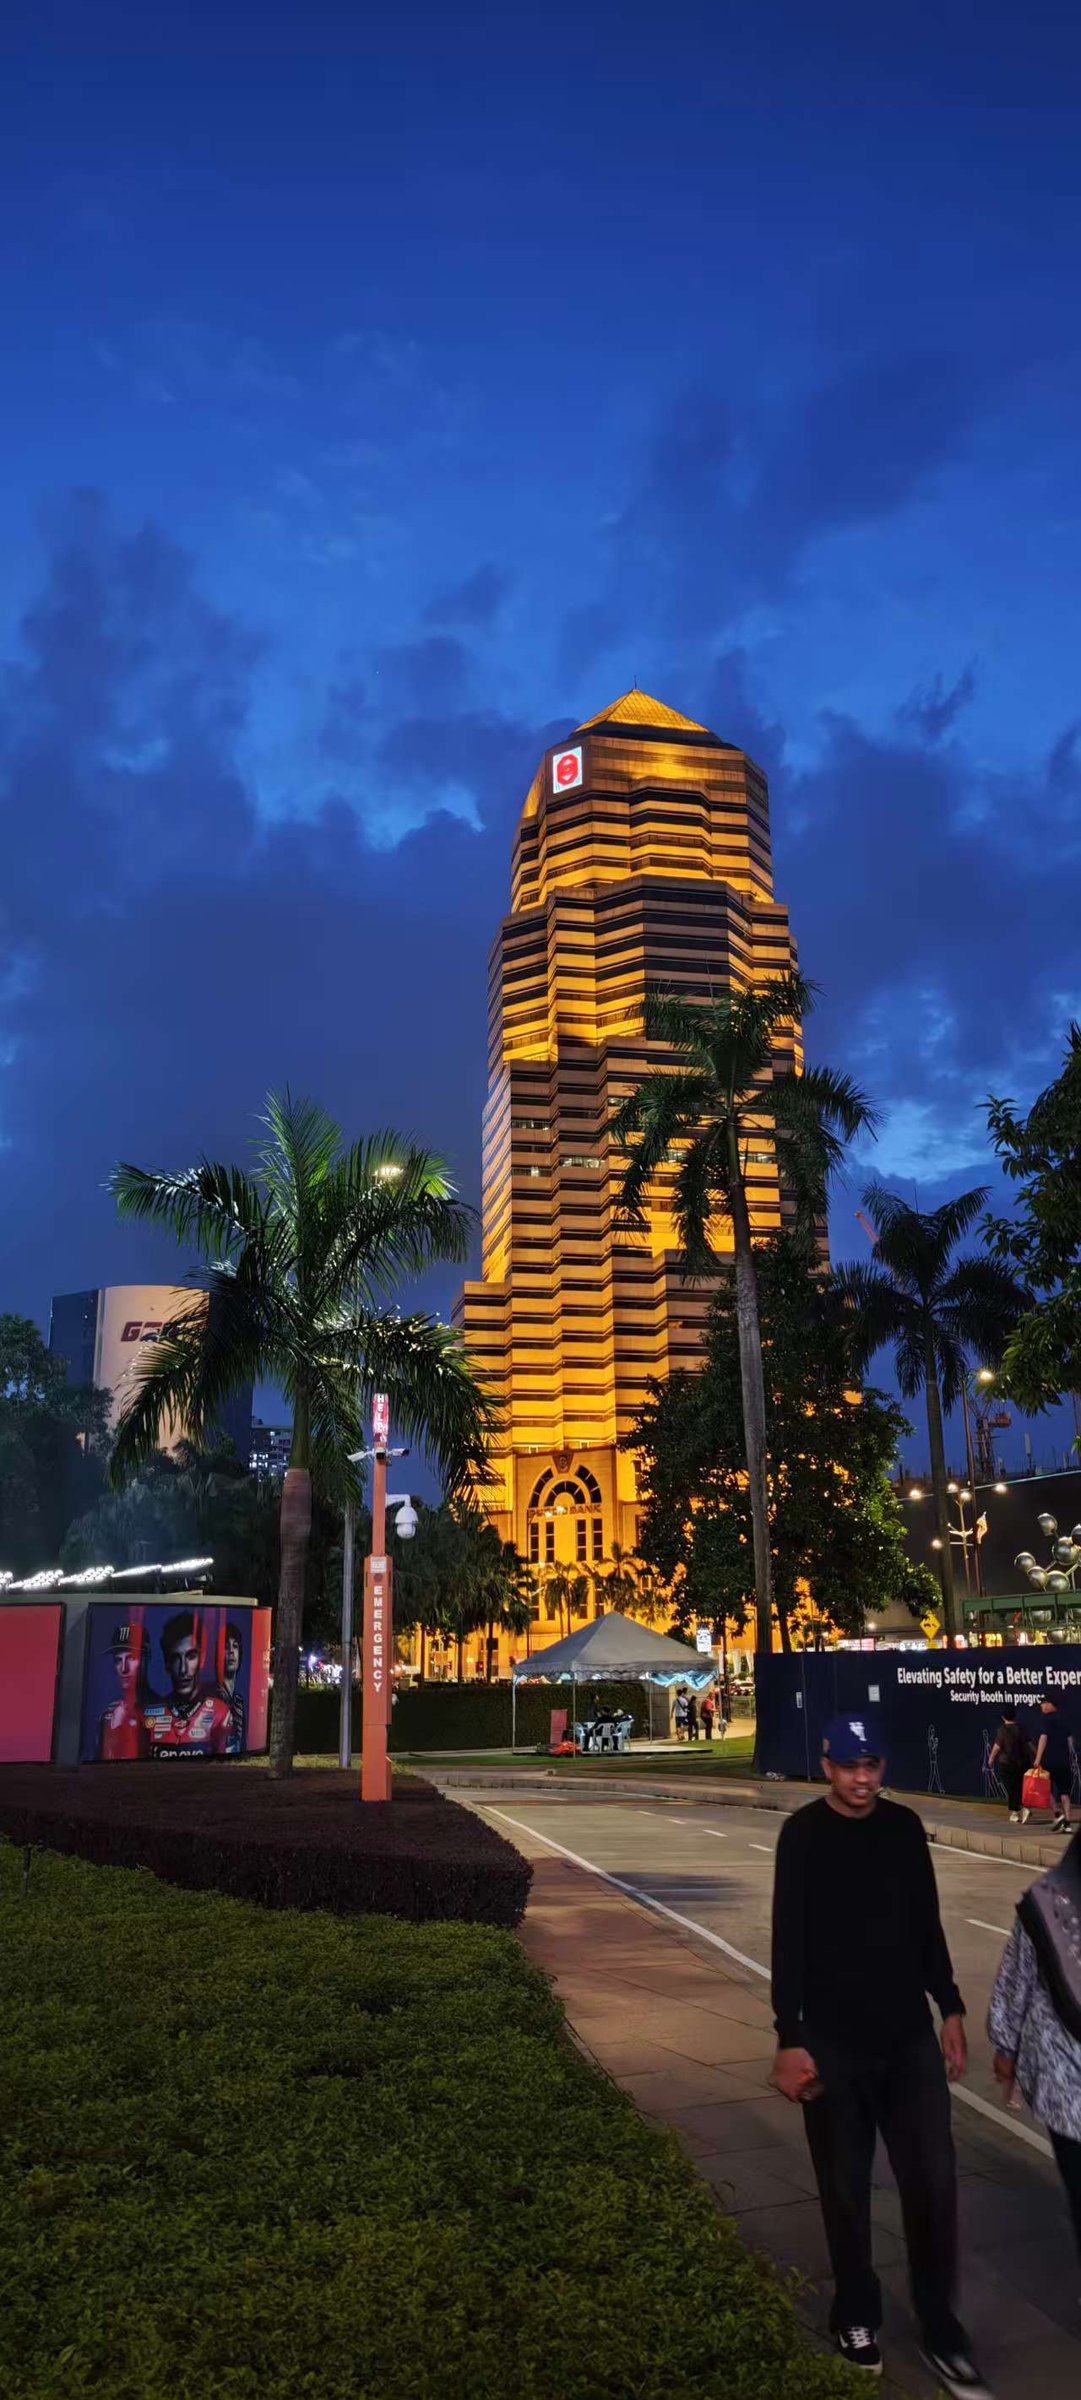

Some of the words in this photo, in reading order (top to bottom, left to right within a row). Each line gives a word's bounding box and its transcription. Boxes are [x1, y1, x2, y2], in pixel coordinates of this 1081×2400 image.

[377, 1392, 385, 1431] HELP
[570, 1503, 602, 1515] BANK
[373, 1585, 383, 1693] EMERGENCY
[897, 1667, 942, 1688] Elevating
[944, 1667, 976, 1688] Safety
[978, 1667, 994, 1685] for
[997, 1671, 1004, 1685] a
[1006, 1666, 1043, 1685] Better
[950, 1689, 980, 1705] Security
[980, 1690, 1004, 1703] Booth
[1005, 1691, 1013, 1703] in
